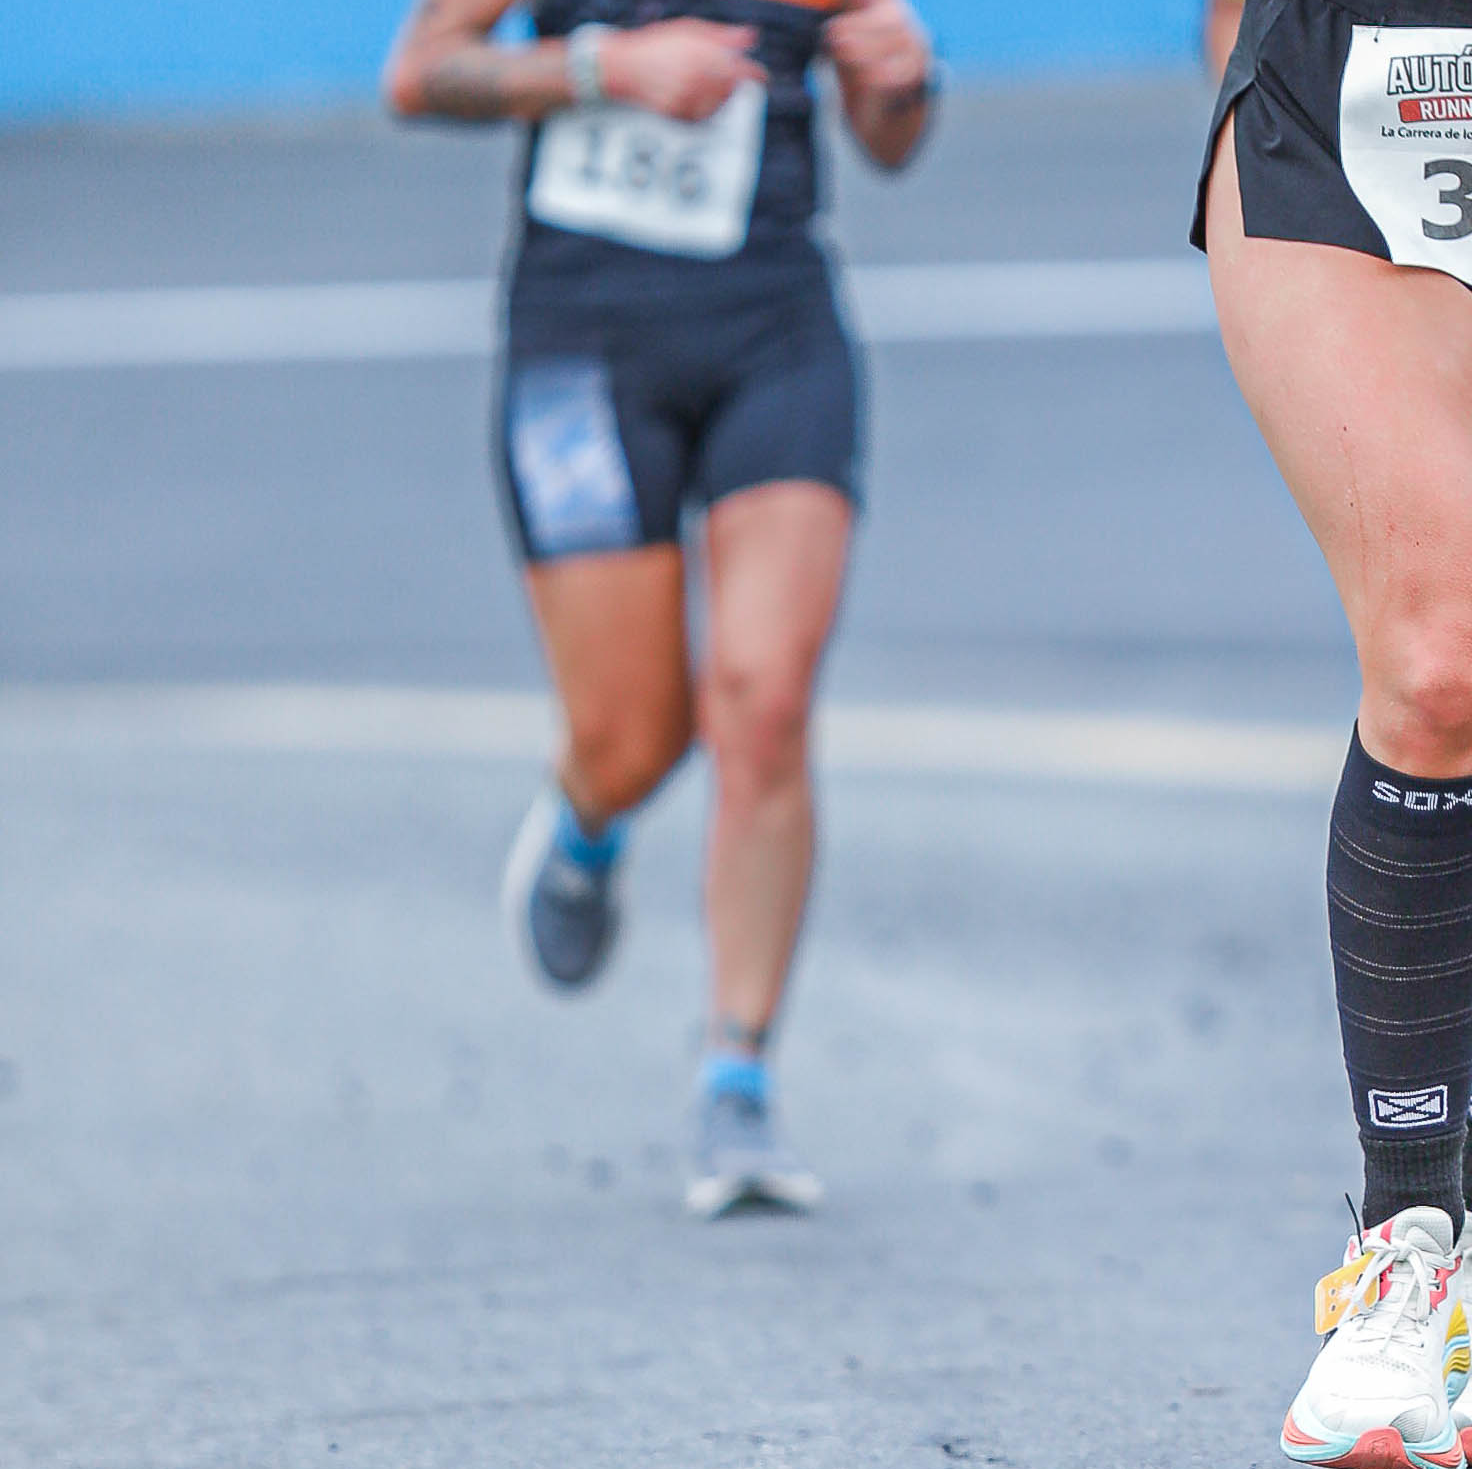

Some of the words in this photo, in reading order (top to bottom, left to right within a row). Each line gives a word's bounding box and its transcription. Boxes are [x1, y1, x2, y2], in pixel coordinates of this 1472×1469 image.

[1381, 125, 1395, 137] La
[1398, 126, 1442, 139] Carrera
[1445, 128, 1460, 139] de
